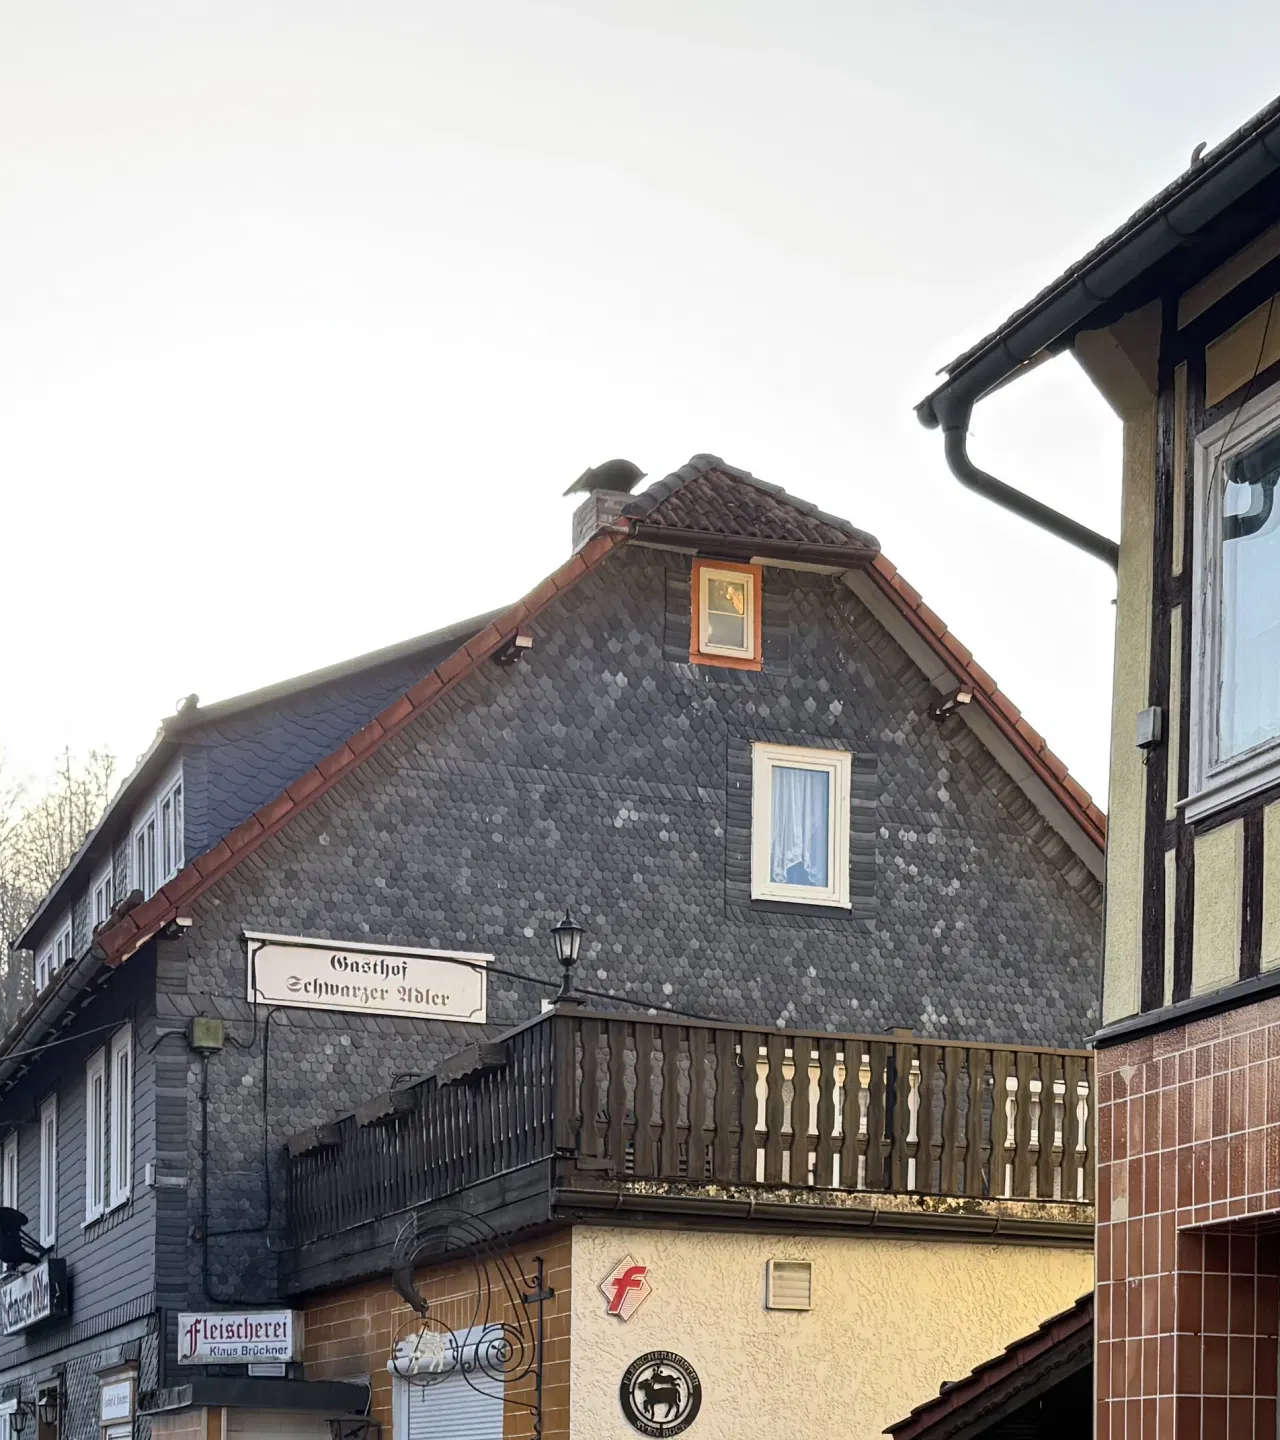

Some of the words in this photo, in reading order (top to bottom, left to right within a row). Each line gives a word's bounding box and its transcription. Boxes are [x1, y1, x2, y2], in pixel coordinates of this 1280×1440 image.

[330, 953, 408, 981] Gasthof
[286, 975, 389, 1004] Schwarzer
[397, 985, 450, 1007] Adler
[181, 1316, 288, 1359] Fleischerei
[209, 1344, 238, 1357] Klaus
[241, 1344, 289, 1356] Brückner
